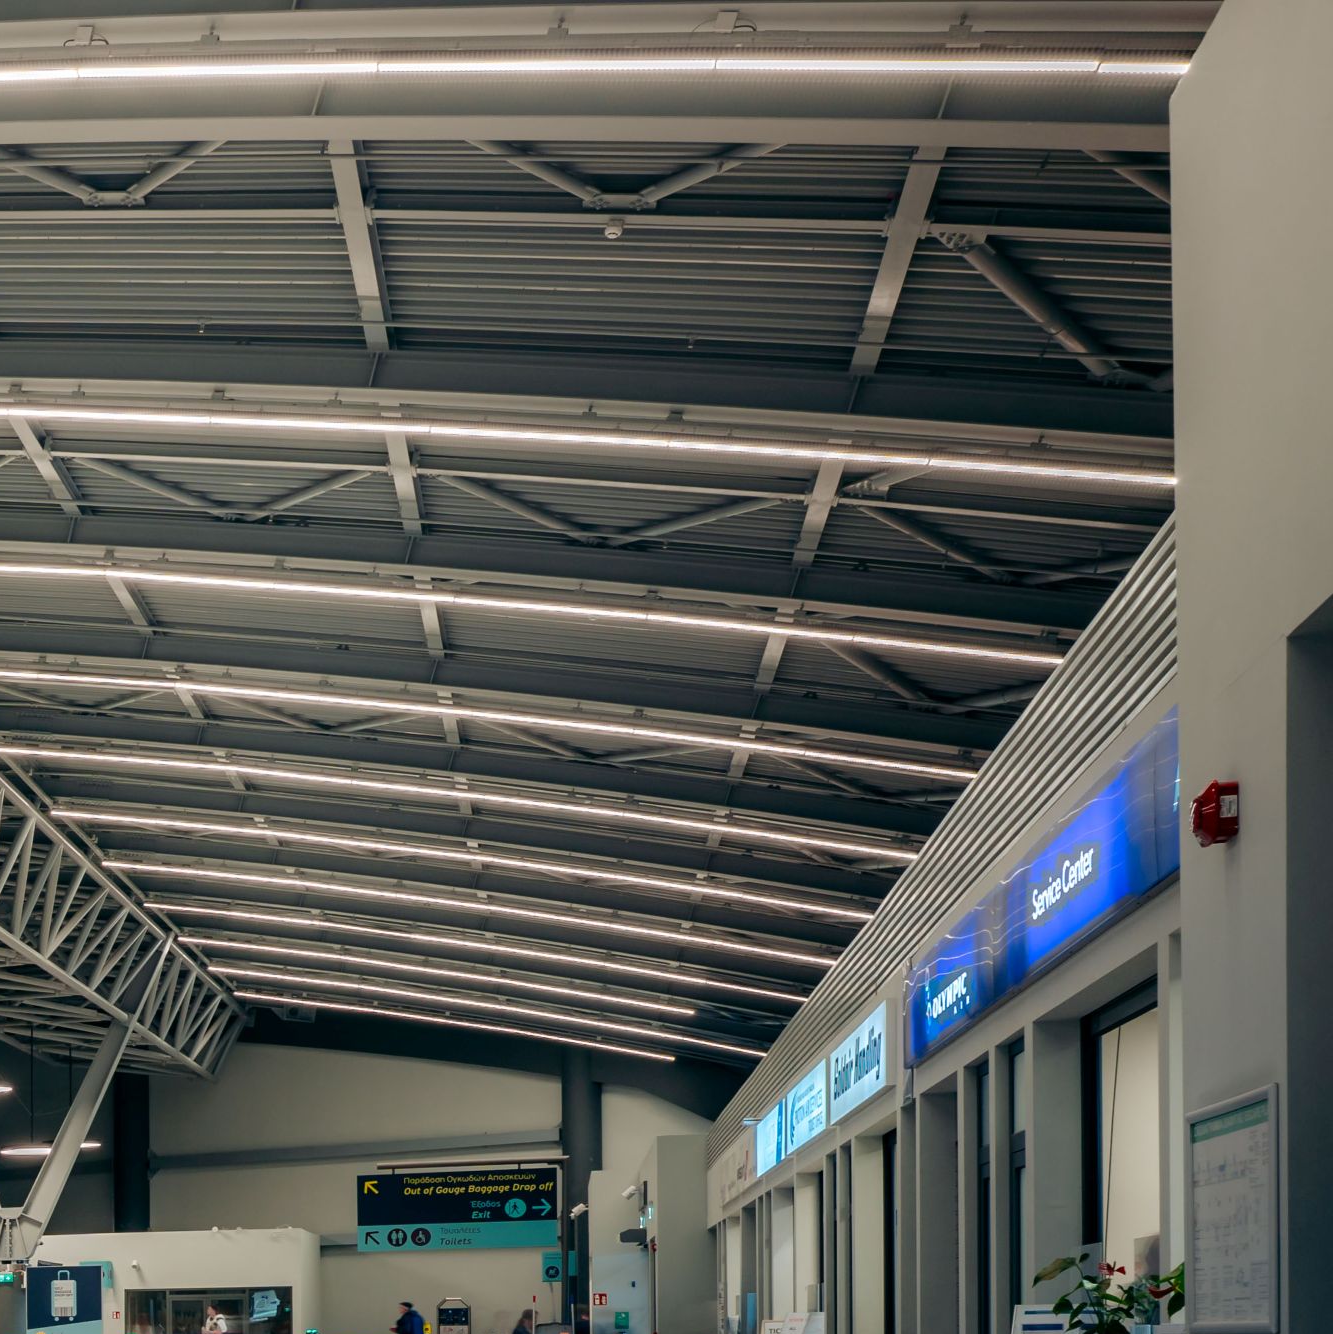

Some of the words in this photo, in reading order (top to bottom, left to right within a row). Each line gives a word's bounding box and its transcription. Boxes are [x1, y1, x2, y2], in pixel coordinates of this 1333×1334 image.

[1032, 876, 1062, 920] Service
[1062, 848, 1094, 893] Center
[933, 972, 967, 1019] OLYMPIC
[953, 996, 970, 1015] AIR
[853, 1026, 882, 1085] Handling
[403, 1176, 446, 1185] Παράδοση
[404, 1187, 421, 1195] Out
[423, 1187, 434, 1195] of
[435, 1186, 466, 1196] Gauge
[468, 1185, 510, 1195] Baggage
[512, 1183, 537, 1193] Drop
[539, 1182, 555, 1191] off
[471, 1200, 501, 1208] Έξοδος
[471, 1211, 490, 1219] Exit
[440, 1237, 472, 1245] Toilets
